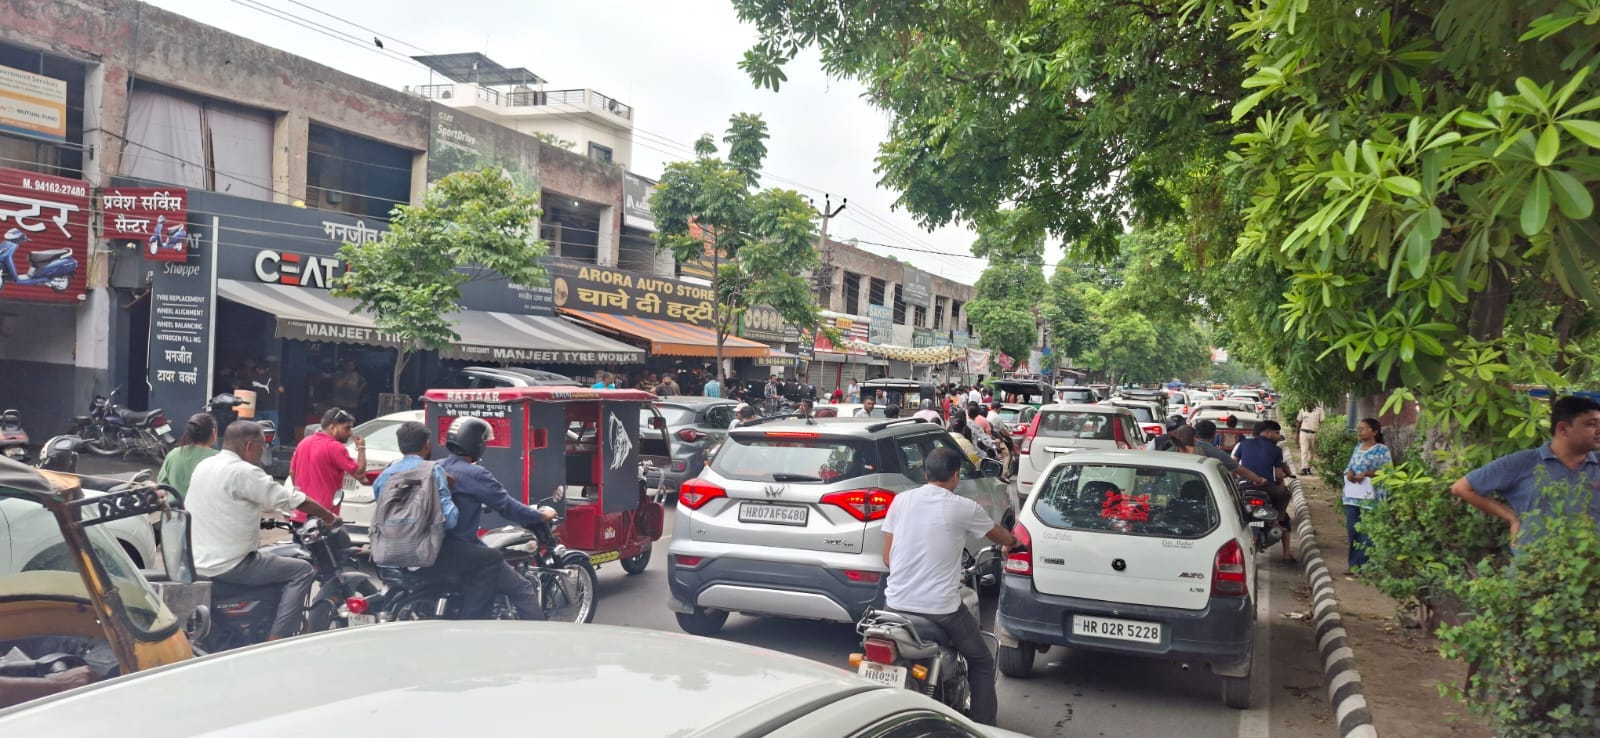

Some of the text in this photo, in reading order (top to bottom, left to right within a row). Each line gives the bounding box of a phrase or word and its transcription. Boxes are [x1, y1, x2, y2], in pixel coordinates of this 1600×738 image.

[103, 190, 181, 211] प्रवेश सर्विस
[114, 214, 149, 234] सैन्टर
[163, 262, 200, 277] Shoppe
[255, 250, 339, 288] CEAT
[577, 266, 633, 288] ARORA
[637, 277, 674, 295] AUTO
[676, 285, 715, 301] STORE
[169, 295, 205, 303] REPLACEMENT
[577, 288, 630, 310] चाचे
[636, 292, 662, 314] दी
[174, 322, 203, 330] BALANCING
[306, 323, 373, 341] MANJEET
[156, 334, 182, 342] NITROGEN
[165, 346, 193, 364] मनजीत
[493, 348, 560, 361] MANJEET
[563, 351, 595, 362] TYRE
[597, 352, 638, 362] WORKS
[157, 370, 176, 383] टायर
[446, 391, 500, 402] RAFTAAR
[745, 506, 806, 522] HR07AF6480
[1177, 571, 1205, 580] ALTO
[1083, 619, 1159, 640] HR 02R 5228
